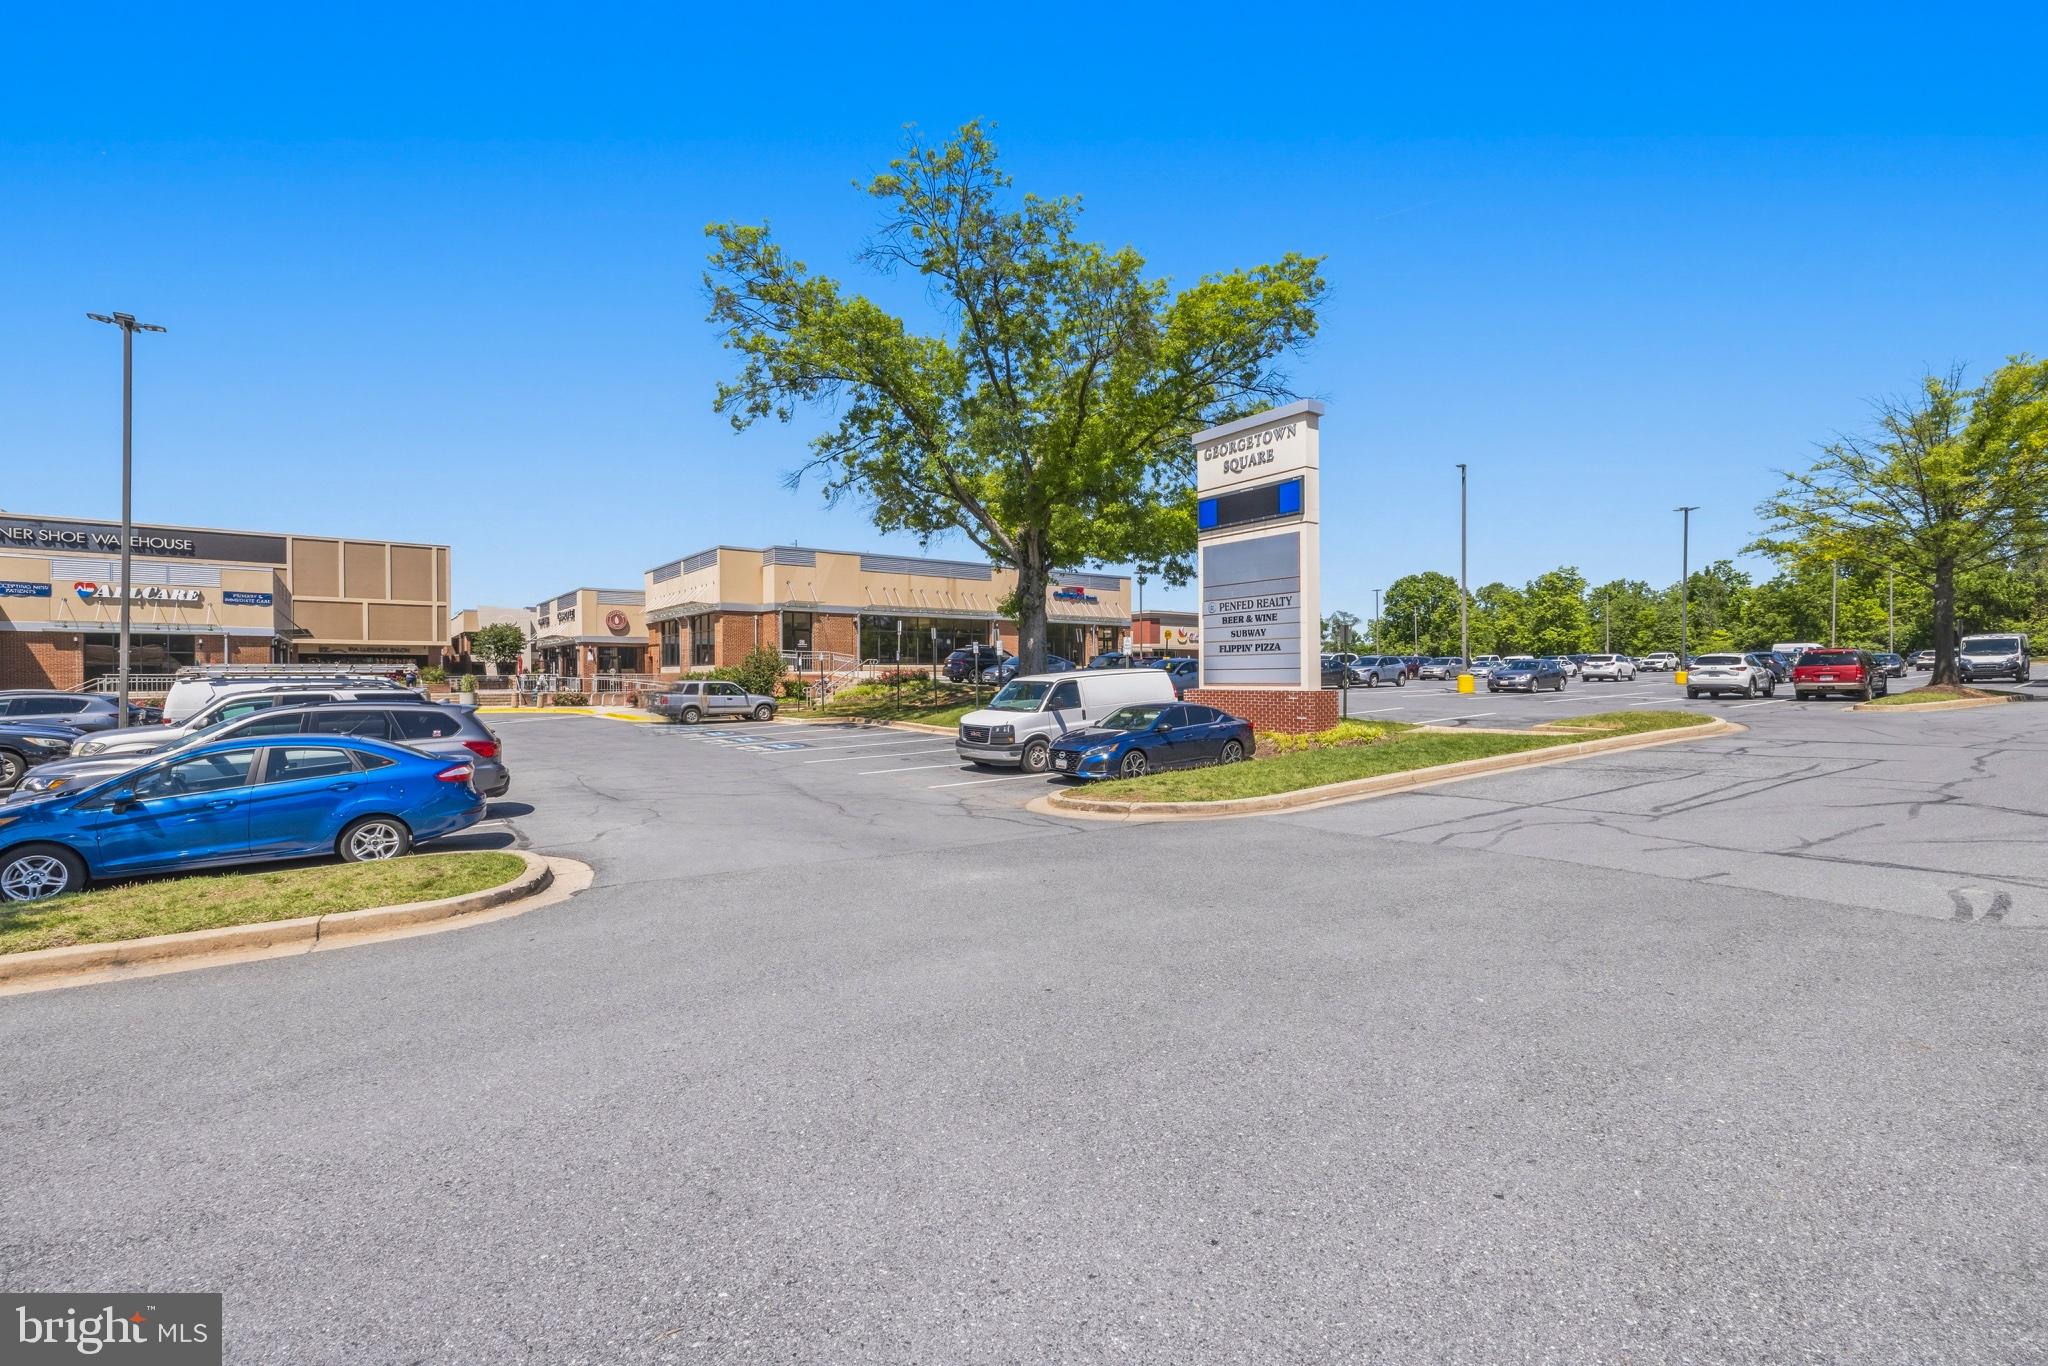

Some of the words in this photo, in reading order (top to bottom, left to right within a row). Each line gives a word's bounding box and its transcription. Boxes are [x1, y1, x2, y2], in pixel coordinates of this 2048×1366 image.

[1203, 423, 1297, 462] GEORGETOWN
[1223, 448, 1275, 475] SQUARE
[38, 529, 87, 544] SHOE
[91, 532, 193, 551] WAEHOUSE
[1219, 600, 1254, 613] PENFED
[1256, 595, 1293, 609] REALTY
[1222, 615, 1244, 625] BEER
[1245, 614, 1253, 623] &
[1254, 612, 1278, 622] WINE
[1230, 628, 1267, 638] SUBWAY
[1219, 643, 1253, 653] FLIPPIN'
[1254, 642, 1282, 652] PIZZA
